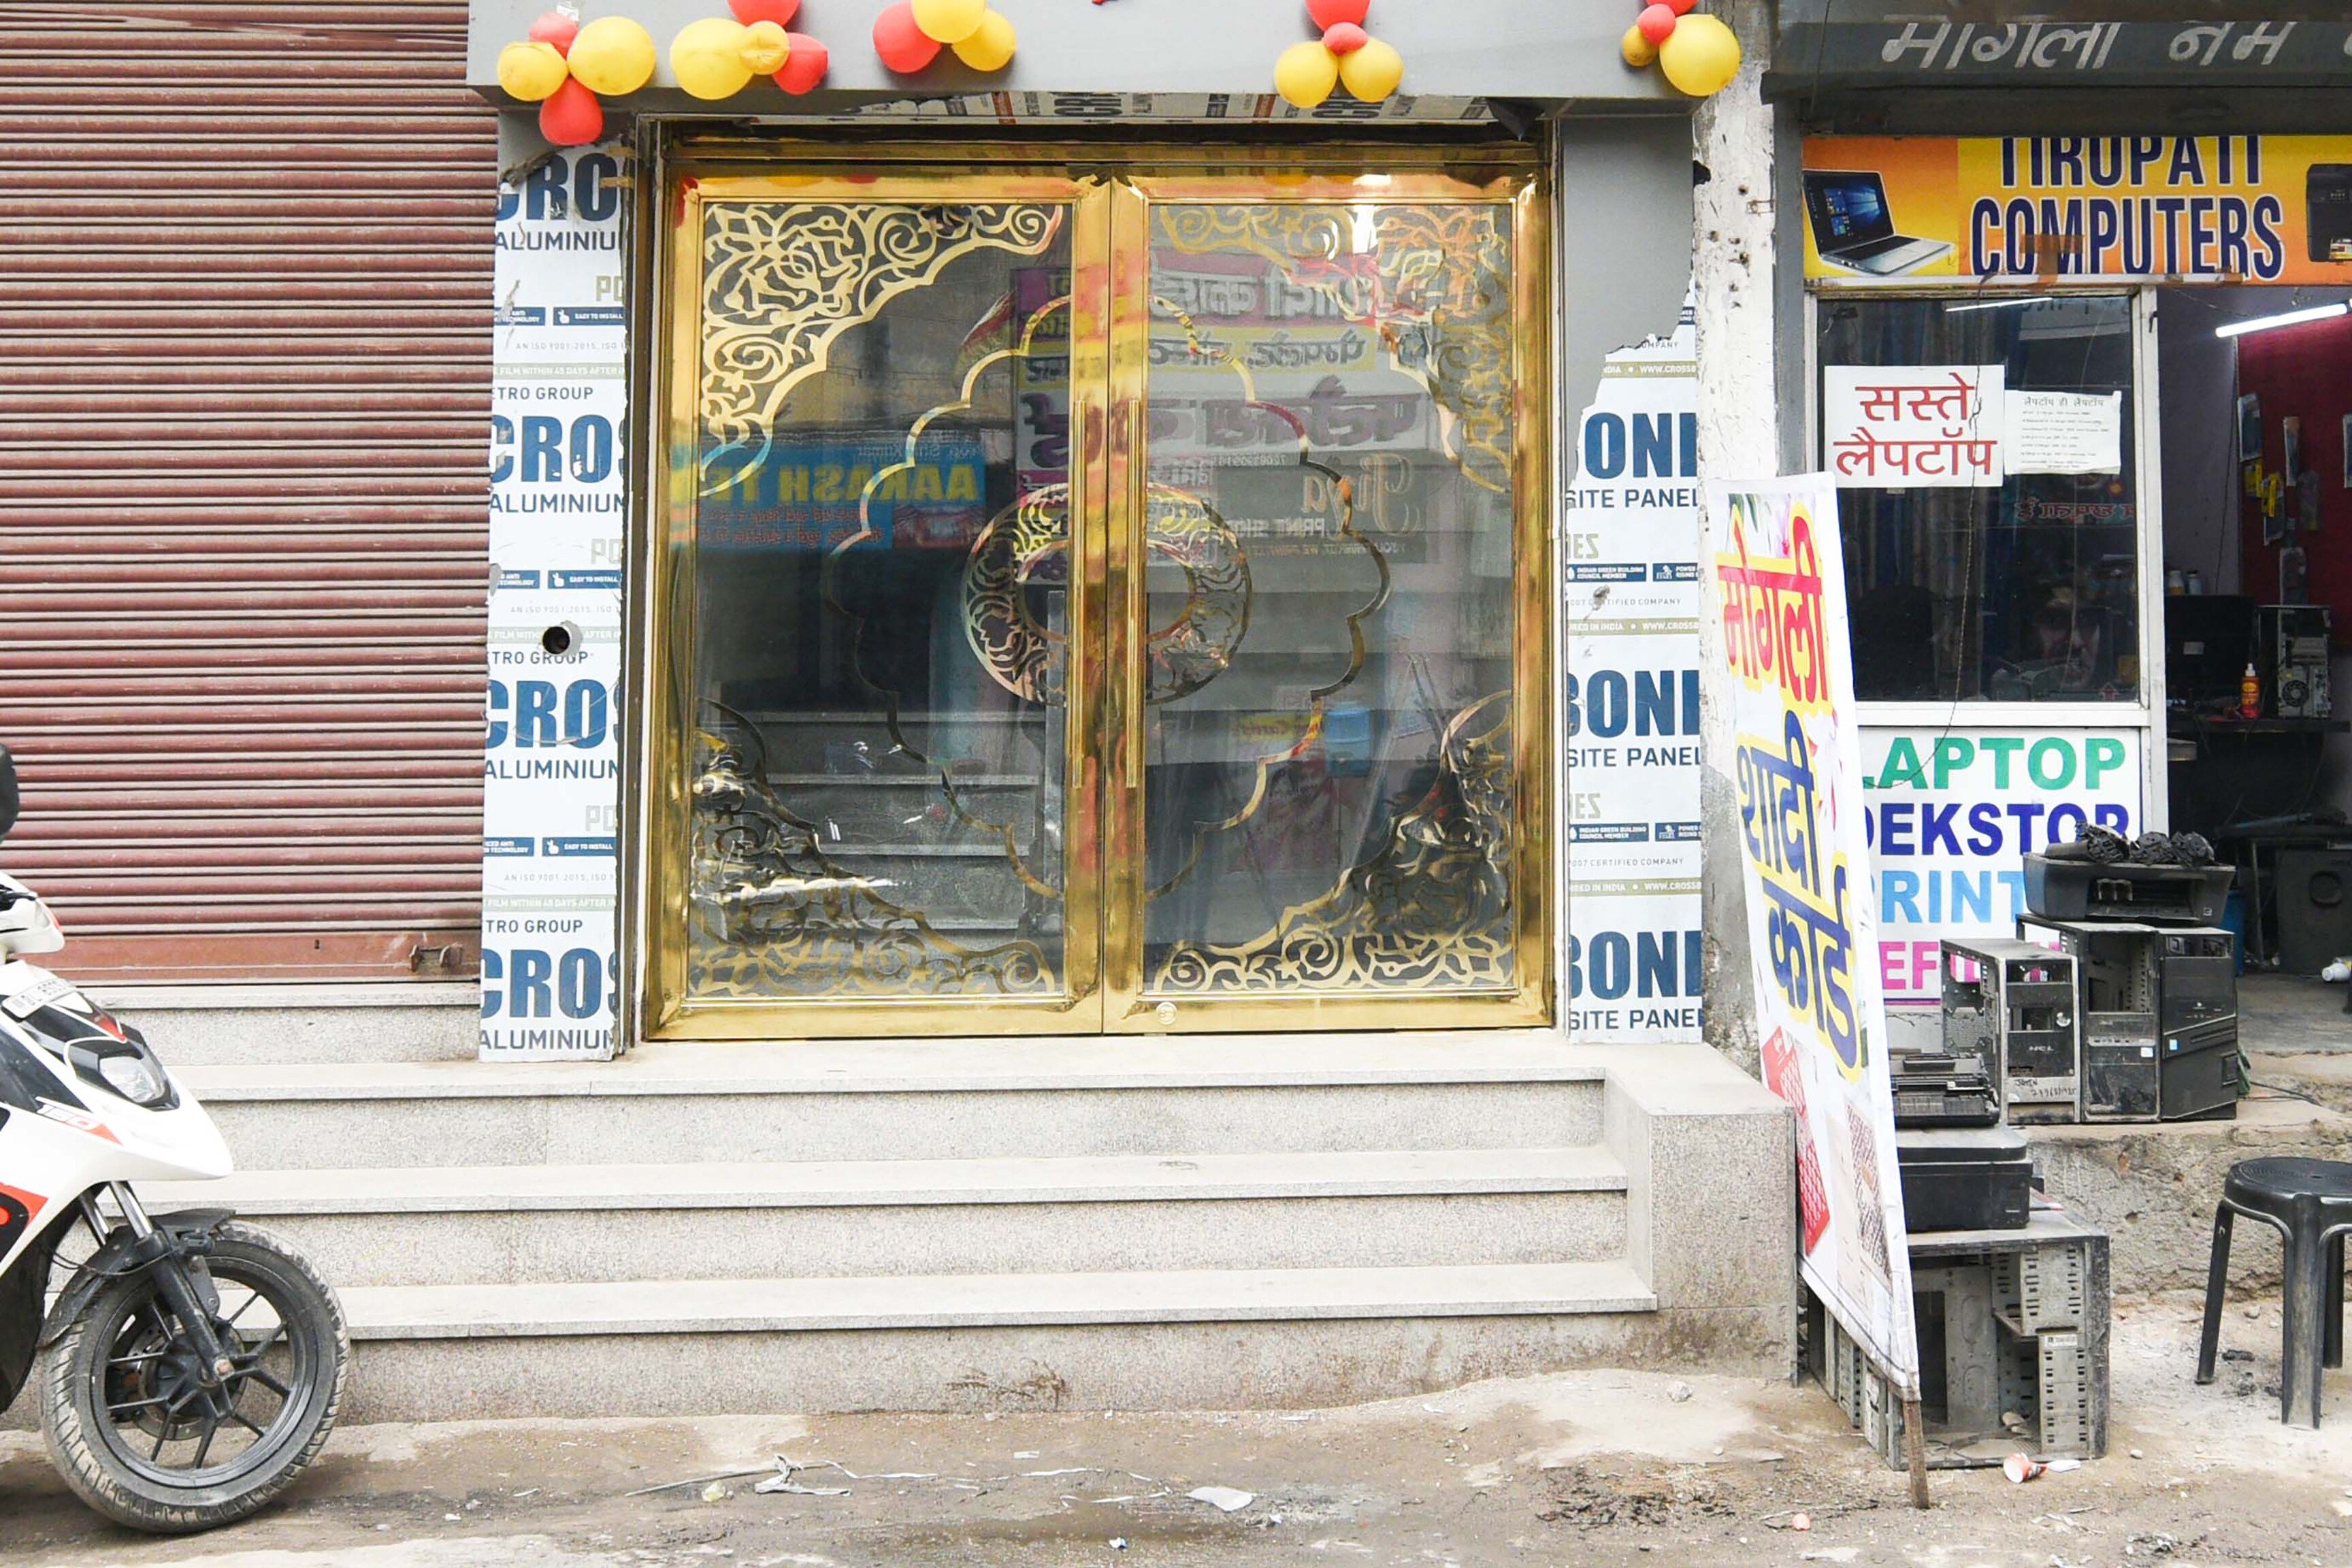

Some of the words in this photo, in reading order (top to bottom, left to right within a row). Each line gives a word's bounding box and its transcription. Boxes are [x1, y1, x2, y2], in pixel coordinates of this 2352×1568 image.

[1972, 195, 2284, 280] COMPUTERS
[536, 387, 594, 400] GROUP
[1855, 372, 1975, 421] सस्ते
[1833, 426, 1998, 476] लैपटॉप
[529, 651, 589, 665] GROUP
[1736, 709, 1822, 897] शादी
[524, 919, 583, 933] GROUP
[1761, 864, 1860, 1070] कार्ड
[1569, 1010, 1619, 1030] SITE
